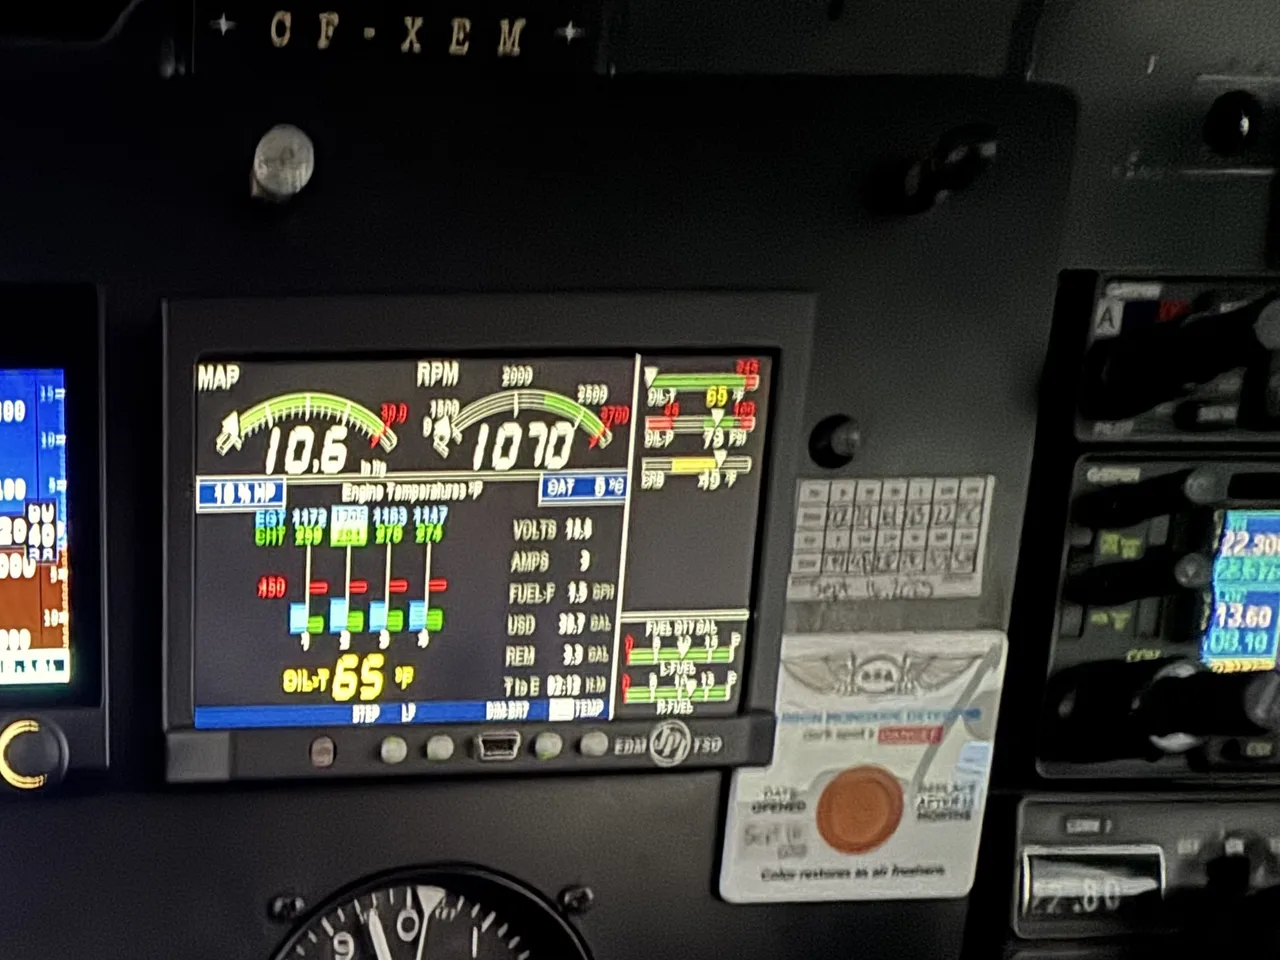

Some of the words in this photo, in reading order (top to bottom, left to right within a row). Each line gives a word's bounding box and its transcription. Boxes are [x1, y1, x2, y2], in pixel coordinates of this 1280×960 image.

[1096, 307, 1116, 330] A
[197, 364, 241, 391] MAP
[416, 360, 460, 388] RPM
[265, 424, 348, 476] 10.6
[472, 421, 576, 472] 1070
[253, 482, 278, 503] HP
[341, 482, 384, 503] Engine
[385, 482, 468, 503] Temperatures
[255, 508, 287, 528] EGT
[513, 518, 557, 541] VOLTS
[510, 550, 550, 573] AMPS
[508, 613, 536, 636] USD
[590, 613, 612, 632] GAL
[646, 620, 673, 637] FUEL
[696, 619, 718, 636] GAL
[505, 645, 536, 667] REM
[587, 645, 610, 663] GAL
[331, 652, 385, 702] 65
[575, 699, 605, 718] TEMP
[614, 738, 647, 756] EDM
[396, 908, 419, 942] 0
[471, 926, 479, 959] 1
